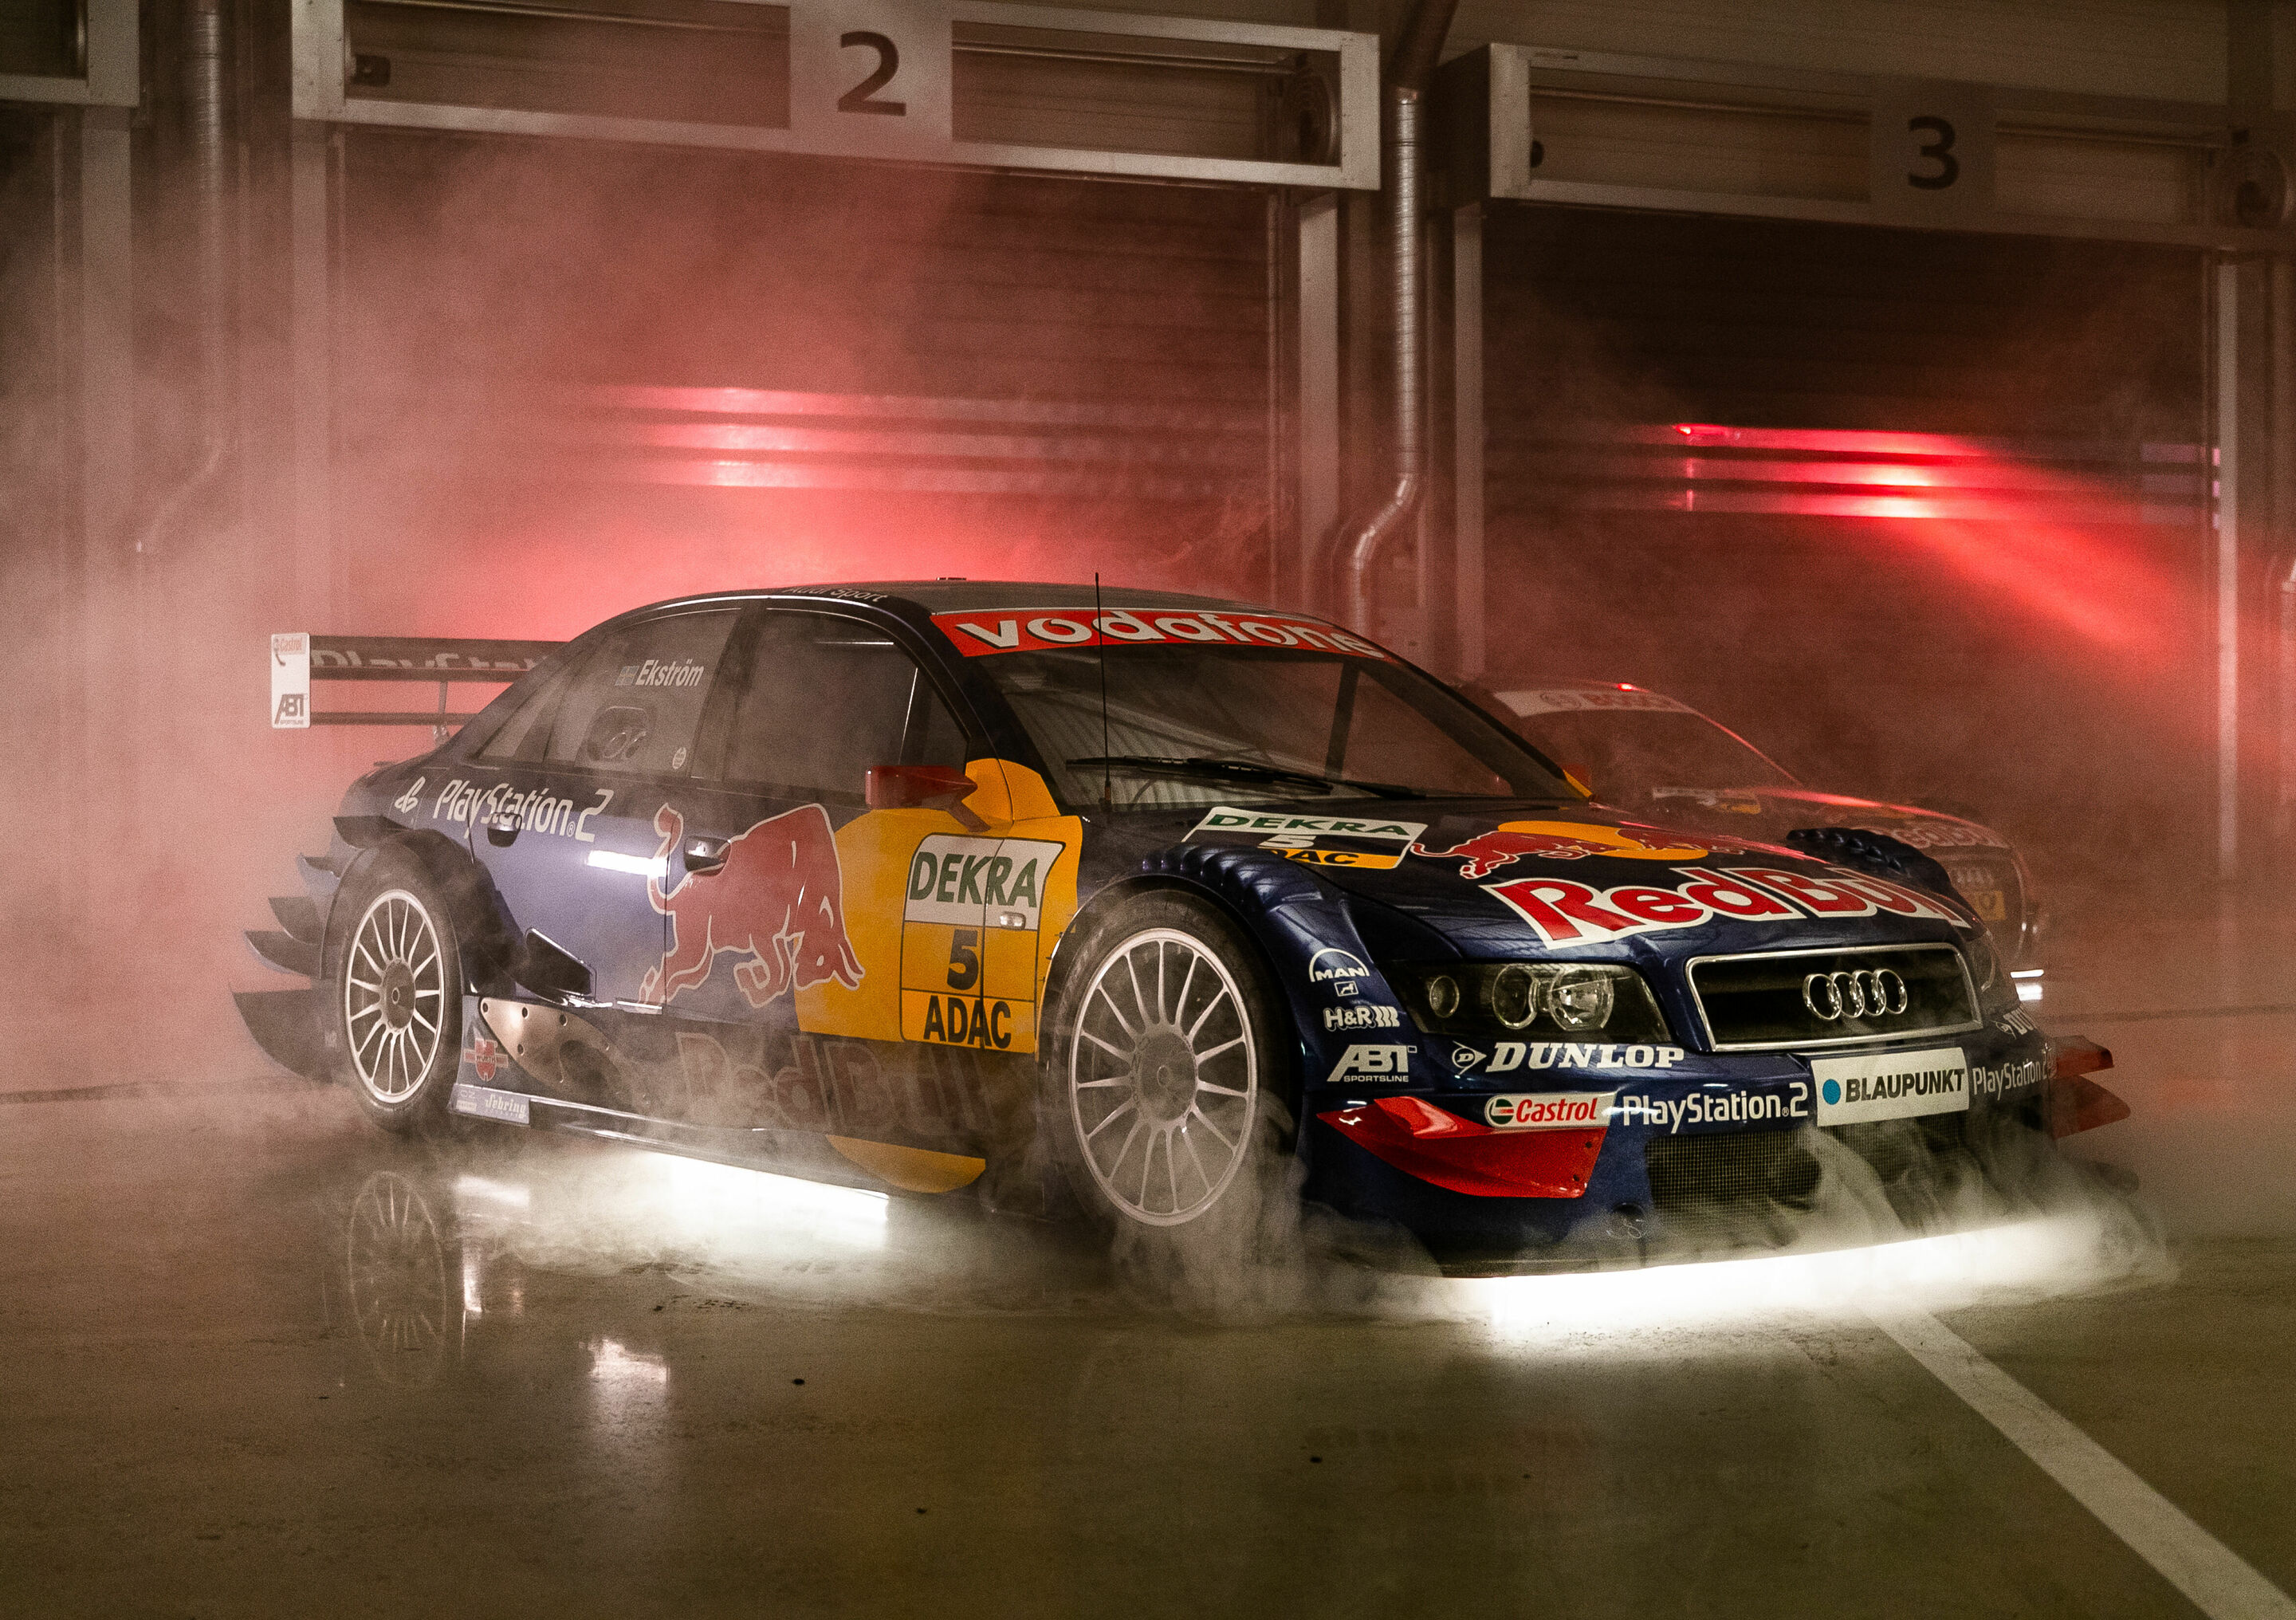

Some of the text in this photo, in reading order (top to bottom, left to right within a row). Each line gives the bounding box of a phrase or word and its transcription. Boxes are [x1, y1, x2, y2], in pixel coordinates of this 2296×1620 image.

[837, 30, 907, 117] 2
[1907, 116, 1960, 191] 3
[635, 659, 705, 686] Ekström
[274, 694, 305, 725] ABT
[1205, 813, 1411, 836] DEKRA
[1256, 834, 1317, 849] 5
[909, 851, 1038, 908] DEKRA
[946, 928, 979, 991] 5
[1315, 967, 1366, 981] MAN
[923, 994, 1012, 1049] ADAC
[1325, 1006, 1374, 1028] H&R
[1327, 1044, 1409, 1082] ABT
[1485, 1041, 1685, 1073] DUNLOP
[1845, 1068, 1965, 1103] BLAUPUNKT
[1972, 1058, 2041, 1101] PlayStation
[1516, 1097, 1598, 1123] Castrol
